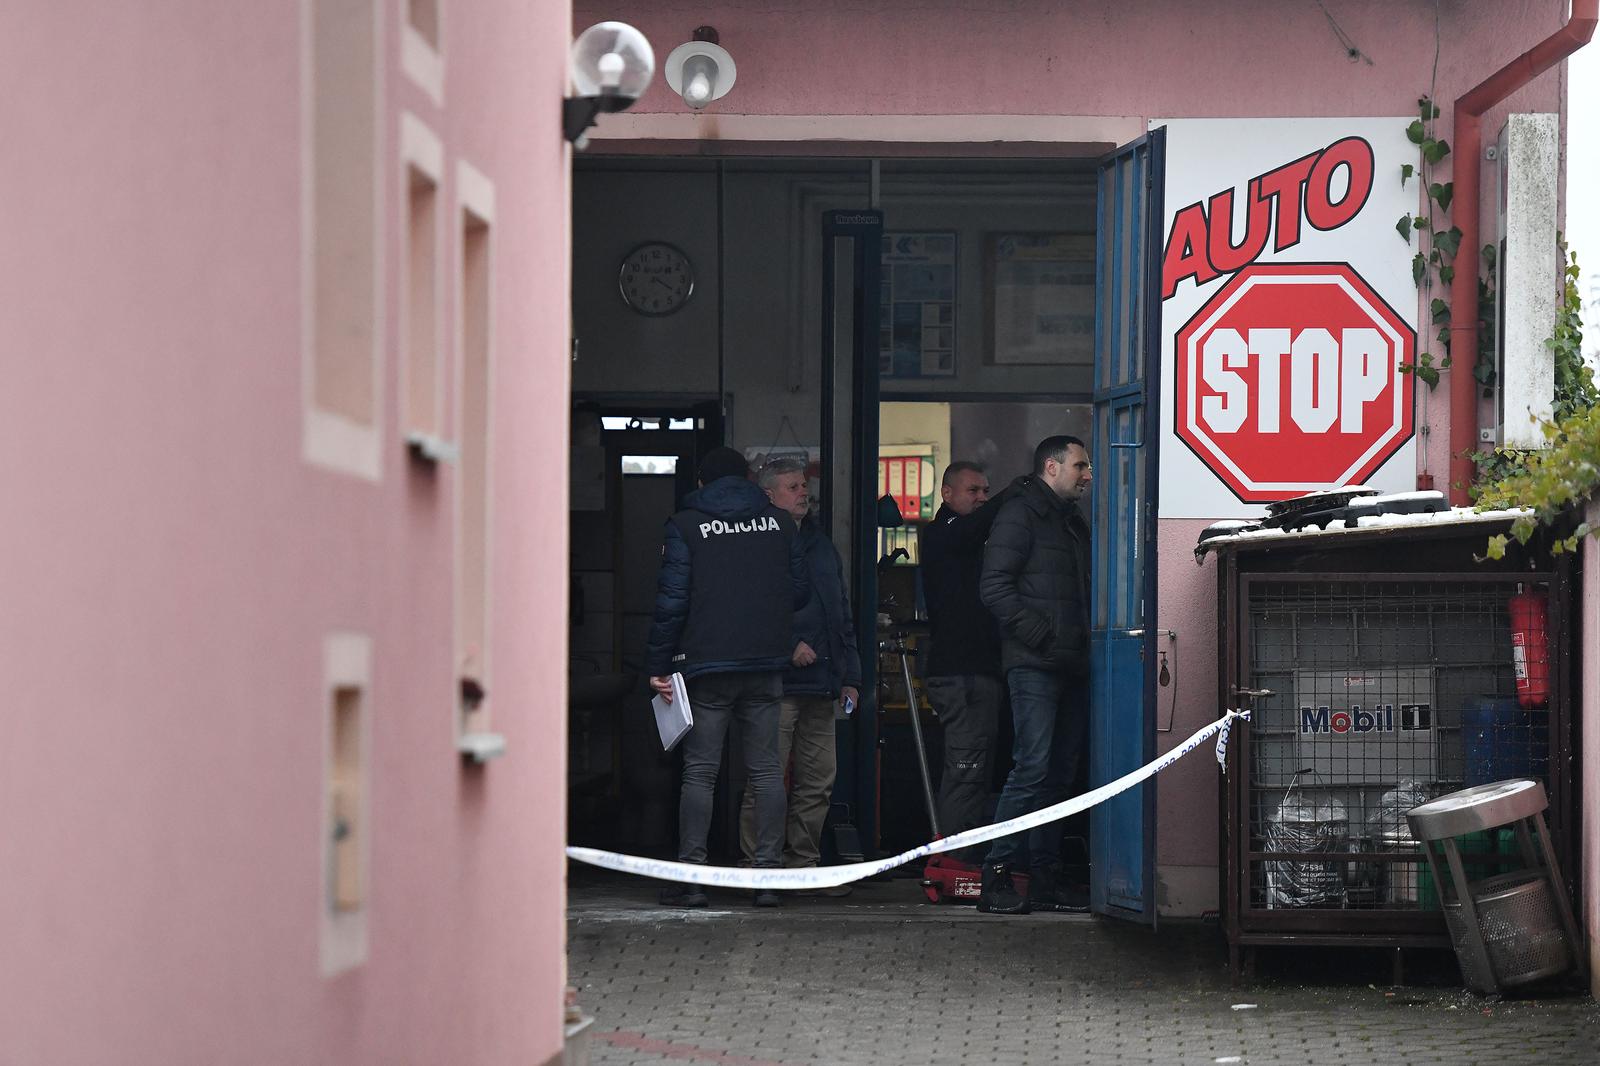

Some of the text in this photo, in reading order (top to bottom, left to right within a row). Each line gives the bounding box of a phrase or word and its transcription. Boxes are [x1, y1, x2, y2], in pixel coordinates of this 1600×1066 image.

[1162, 136, 1375, 302] AUTO
[1202, 327, 1388, 434] STOP
[698, 516, 781, 539] POLICIJA
[1300, 704, 1393, 734] Mobil
